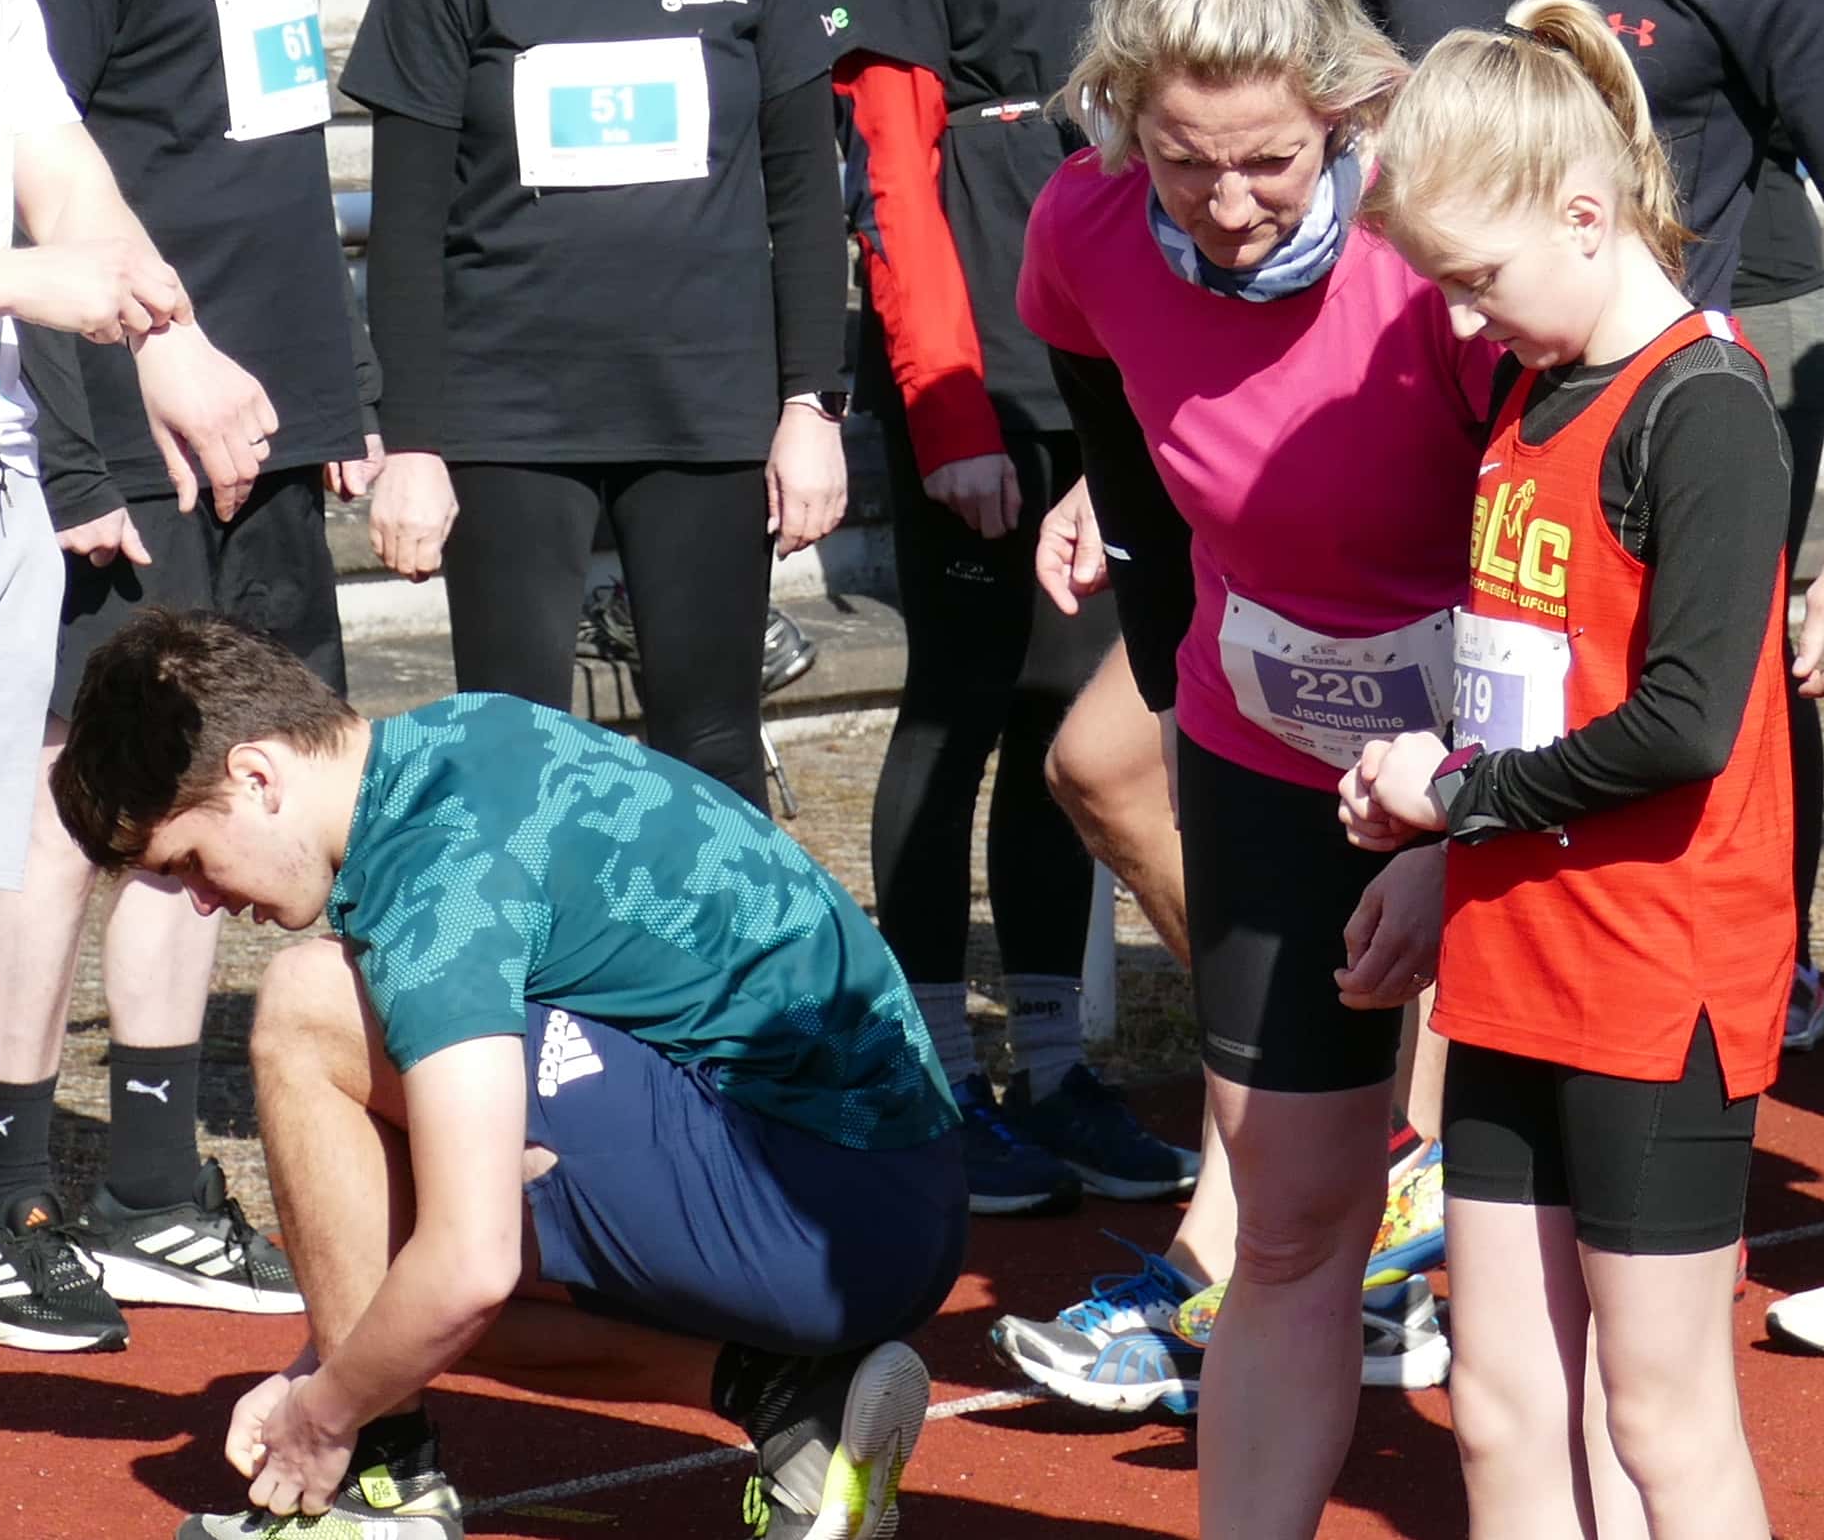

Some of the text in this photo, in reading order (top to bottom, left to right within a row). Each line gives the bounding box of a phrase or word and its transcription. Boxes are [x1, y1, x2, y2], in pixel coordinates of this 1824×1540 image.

[282, 20, 312, 61] 61
[590, 87, 635, 123] 51
[1509, 591, 1567, 618] LUFCLUB
[1290, 668, 1383, 709] 220
[1453, 669, 1492, 724] 219
[1293, 704, 1405, 731] Jacqueline
[537, 1009, 569, 1097] adidas
